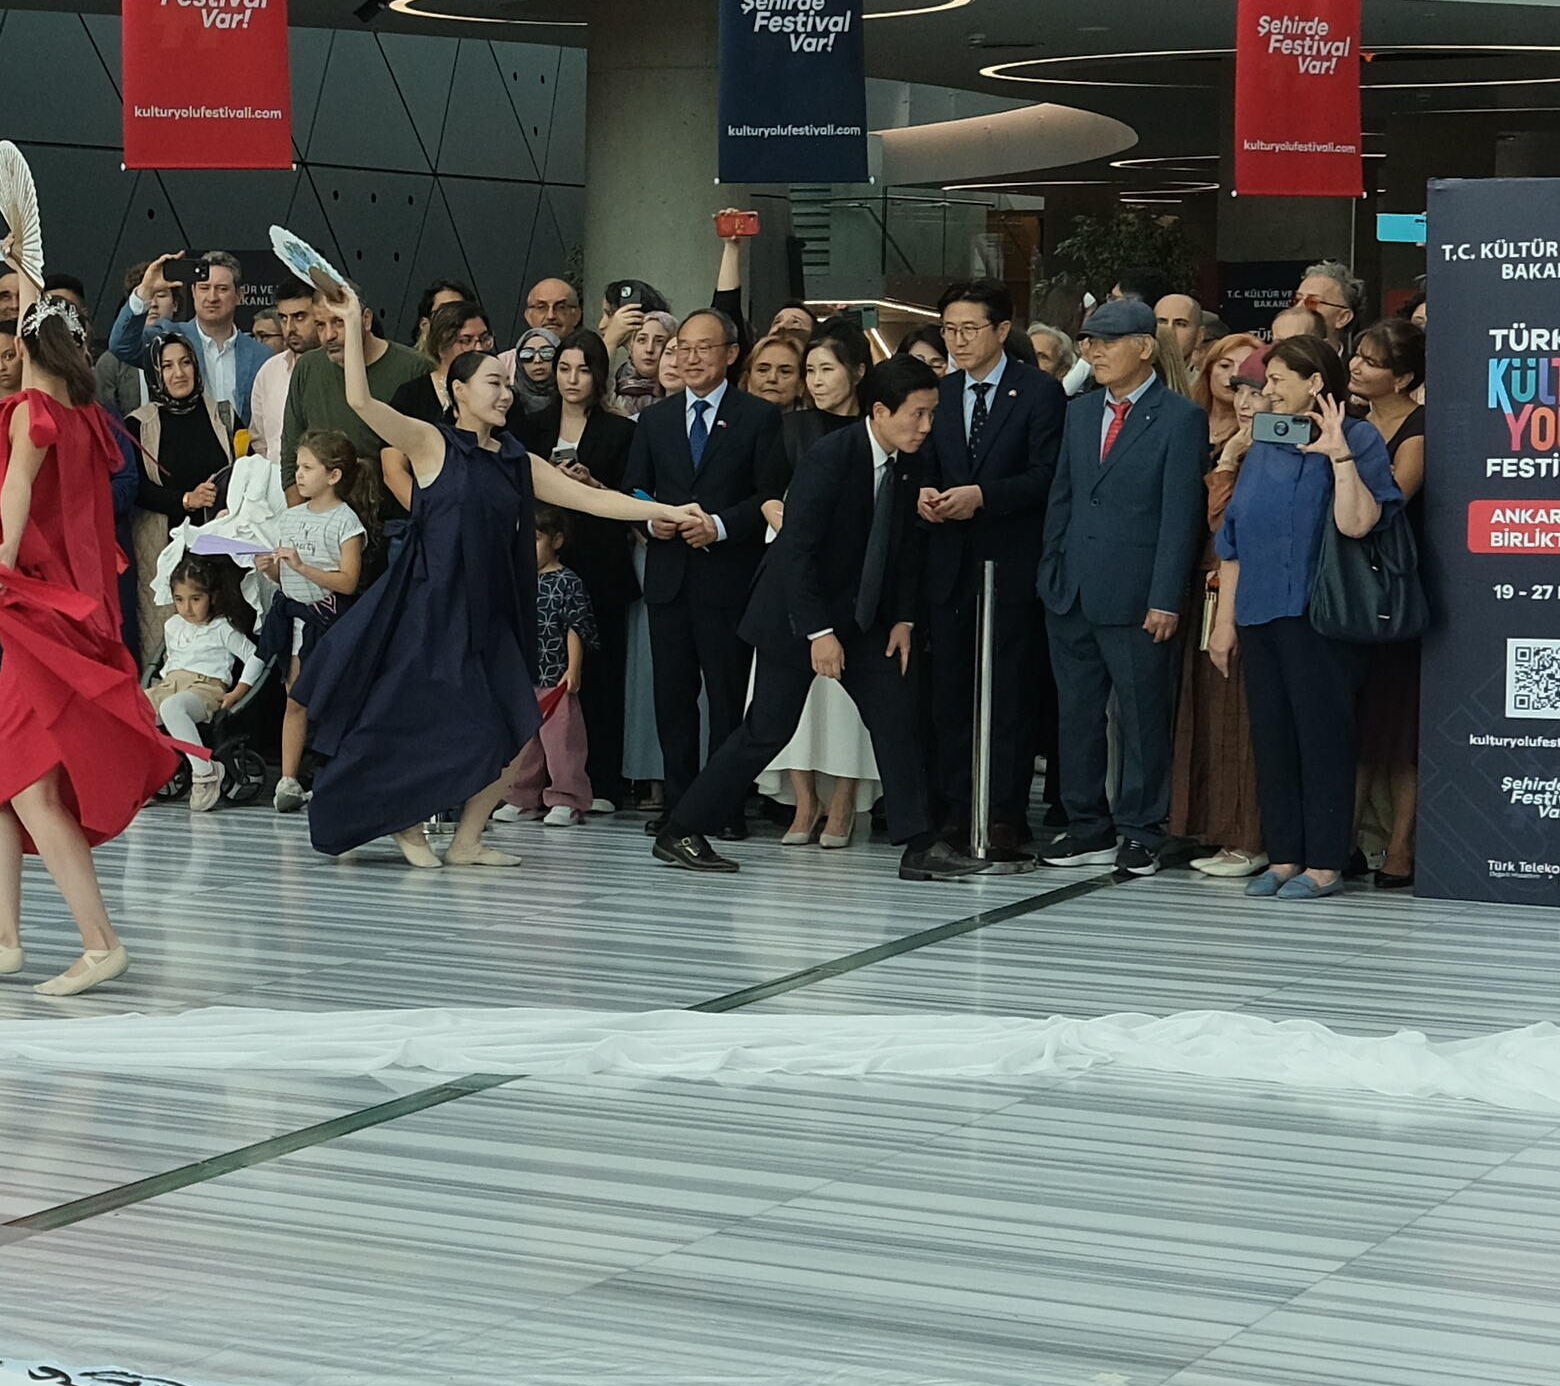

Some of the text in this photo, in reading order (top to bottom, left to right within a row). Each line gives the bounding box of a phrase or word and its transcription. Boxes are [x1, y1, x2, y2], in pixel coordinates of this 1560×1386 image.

[201, 9, 251, 29] Var!
[754, 10, 851, 33] Festival
[1257, 15, 1328, 37] Şehirde
[789, 33, 835, 53] Var!
[1268, 35, 1350, 57] Festival
[1298, 57, 1336, 75] Var!
[134, 106, 281, 120] kulturyolufestivali.com
[728, 124, 861, 137] kulturyolufestivali.com
[1244, 140, 1355, 154] kulturyolufestivali.com
[1442, 244, 1475, 261] T.C.
[1481, 239, 1558, 258] KÜLTÜR
[1494, 585, 1513, 599] 19
[1532, 585, 1553, 600] 27
[1488, 860, 1515, 872] Türk
